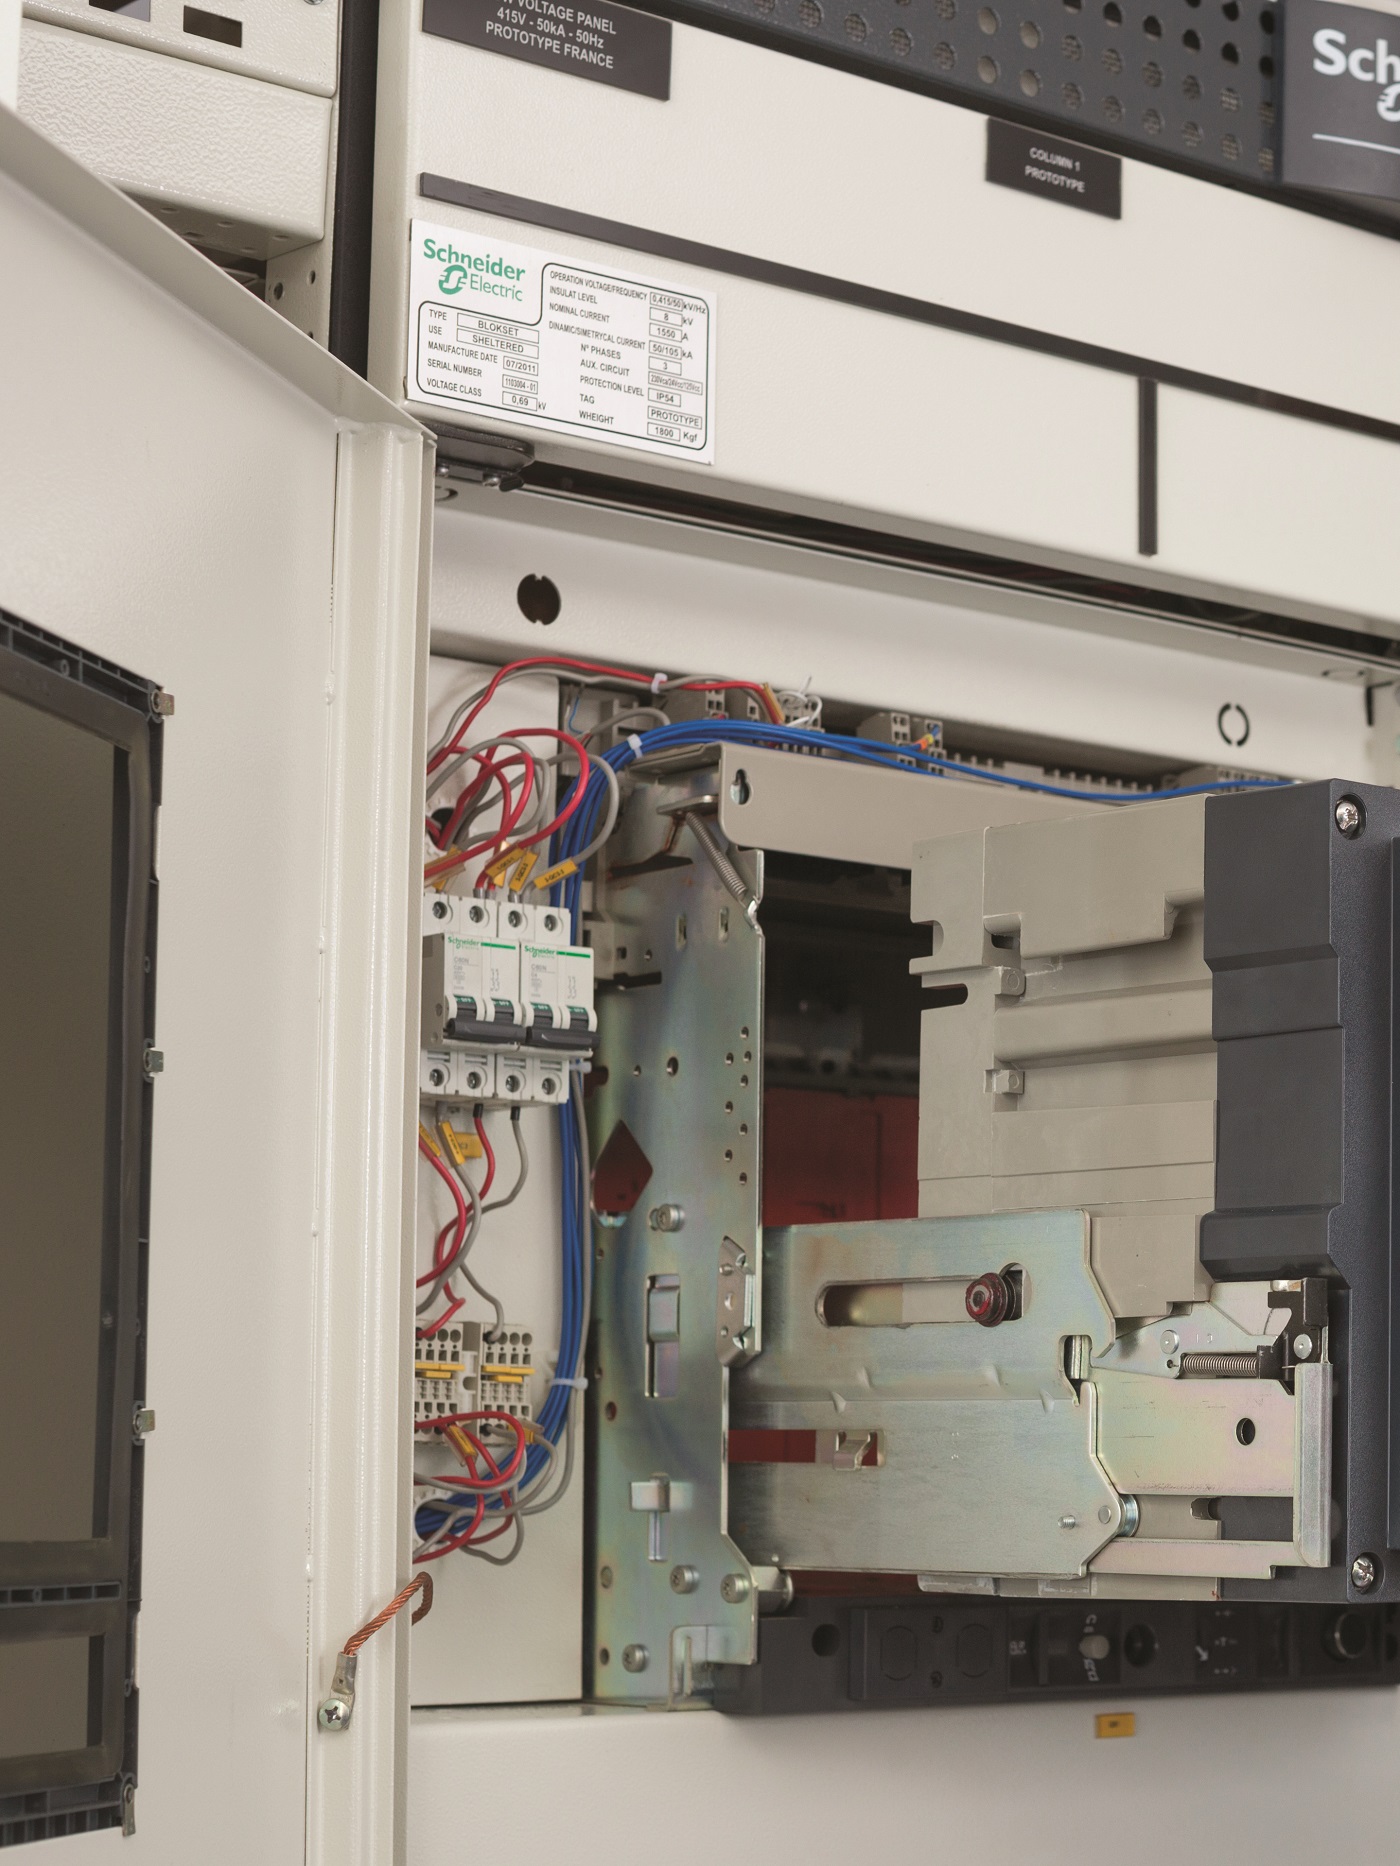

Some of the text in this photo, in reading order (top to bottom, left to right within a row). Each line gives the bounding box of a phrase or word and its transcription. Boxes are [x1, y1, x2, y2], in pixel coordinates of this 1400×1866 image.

[497, 7, 526, 25] 415V
[537, 17, 566, 38] 50kA
[576, 29, 605, 49] 50Hz
[518, 0, 617, 35] VOLTAGE PANEL
[486, 21, 614, 69] PROTOTYPE FRANCE
[1029, 147, 1080, 172] COLUMN 1
[1025, 165, 1085, 193] PROTOTYPE
[424, 238, 526, 281] Schneider
[470, 273, 523, 301] Electric
[550, 271, 584, 285] OPERATION
[585, 278, 647, 301] VOLTAGE/FREQUENCY
[653, 294, 681, 308] 0,415/50
[549, 302, 689, 341] NOMINAL CURRENT 1550 A
[550, 285, 576, 297] INSULAT
[578, 292, 598, 304] LEVEL
[682, 317, 693, 326] kV
[429, 309, 519, 336] TYPE BLOKSET
[429, 325, 524, 353] USE SHELTERED
[549, 321, 693, 359] DINAMIC/SIMETRYCAL CURRENT 50/105 kA
[591, 345, 621, 360] PHASES
[427, 358, 451, 371] SERIAL
[453, 364, 482, 377] NUMBER
[428, 341, 536, 373] MANUFACTURE DATE 07/2011
[580, 359, 598, 370] AUX.
[600, 363, 630, 376] CIRCUIT
[427, 378, 546, 410] VOLTAGE CLASS 0,69 kV
[580, 375, 674, 403] PROTECTION LEVEL IP54
[580, 393, 699, 427] TAG PROTOTYPE
[579, 410, 697, 443] WHEIGHT 1800 Kgf
[448, 935, 480, 946] Schneider
[524, 945, 555, 955] Schneider
